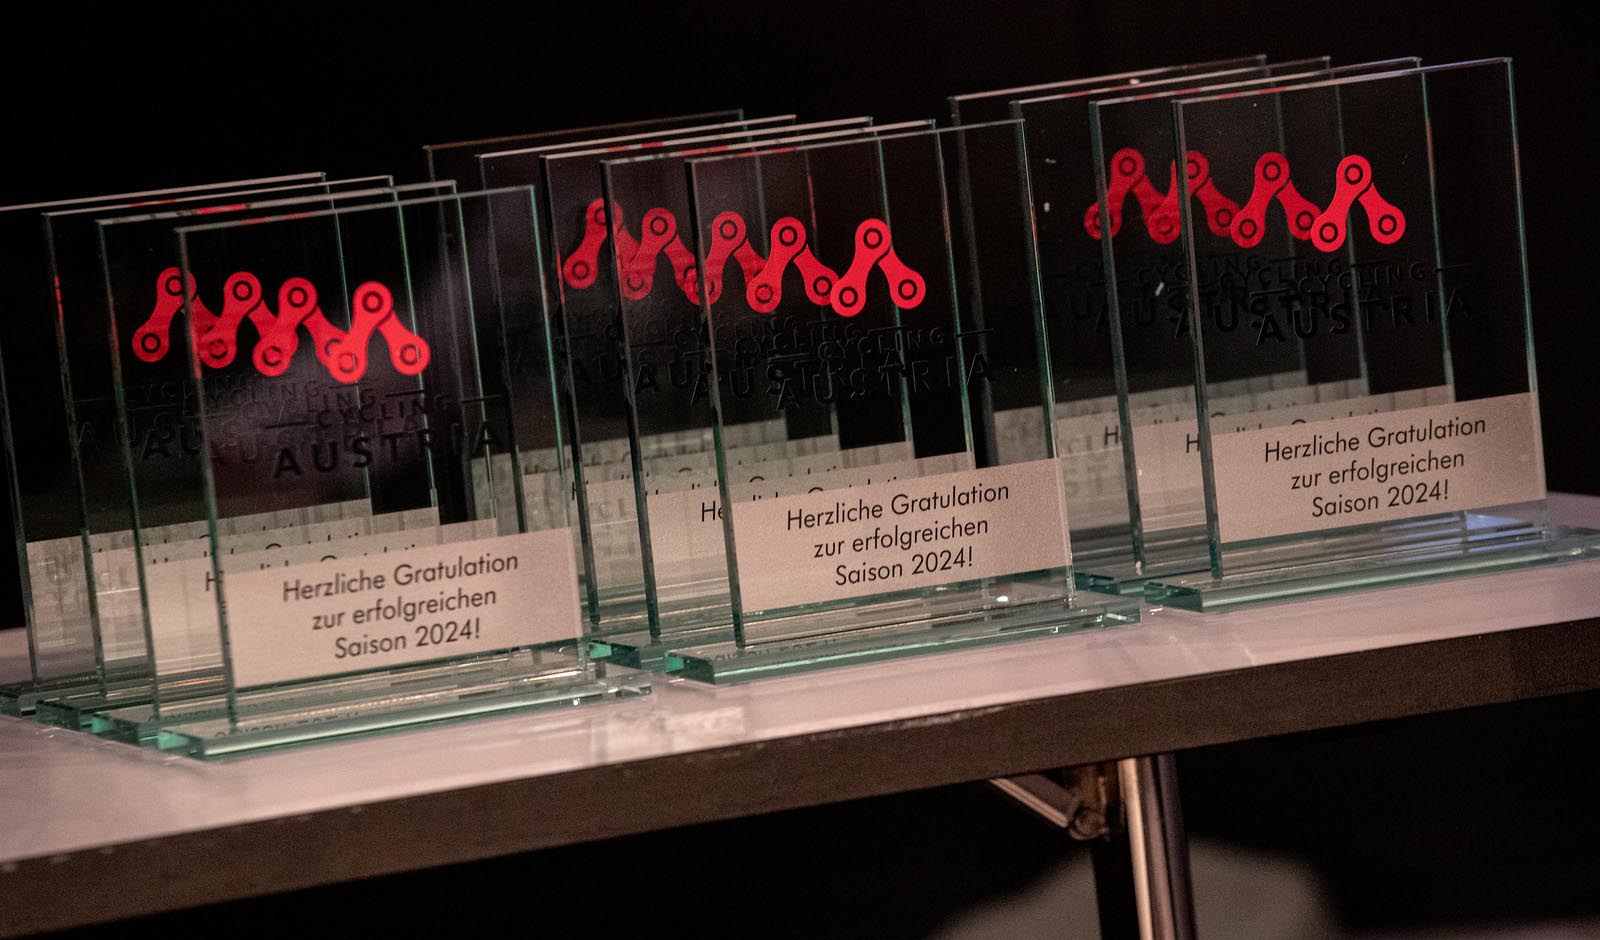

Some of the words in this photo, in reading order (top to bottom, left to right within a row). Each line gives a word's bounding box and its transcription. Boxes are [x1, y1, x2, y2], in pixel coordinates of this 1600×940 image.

[1298, 261, 1427, 295] CYCLING
[1255, 287, 1472, 346] AUSTRIA
[817, 326, 946, 359] CYCLING
[776, 352, 995, 411] AUSTRIA
[317, 391, 451, 429] CYCLING
[274, 420, 505, 479] AUSTRIA
[1265, 432, 1360, 463] Herzliche
[1367, 416, 1487, 449] Gratulation
[1291, 471, 1322, 490] zur
[1329, 449, 1465, 485] erfolgreichen
[787, 499, 884, 530] Herzliche
[891, 484, 1010, 516] Gratulation
[1312, 492, 1379, 518] Saison
[1387, 479, 1450, 508] 2024!
[814, 540, 845, 558] zur
[852, 516, 989, 553] erfolgreichen
[282, 572, 386, 603] Herzliche
[393, 553, 519, 587] Gratulation
[835, 560, 904, 587] Saison
[911, 546, 974, 576] 2024!
[312, 611, 345, 631] zur
[352, 588, 497, 626] erfolgreichen
[334, 631, 407, 660] Saison
[415, 618, 481, 648] 2024!
